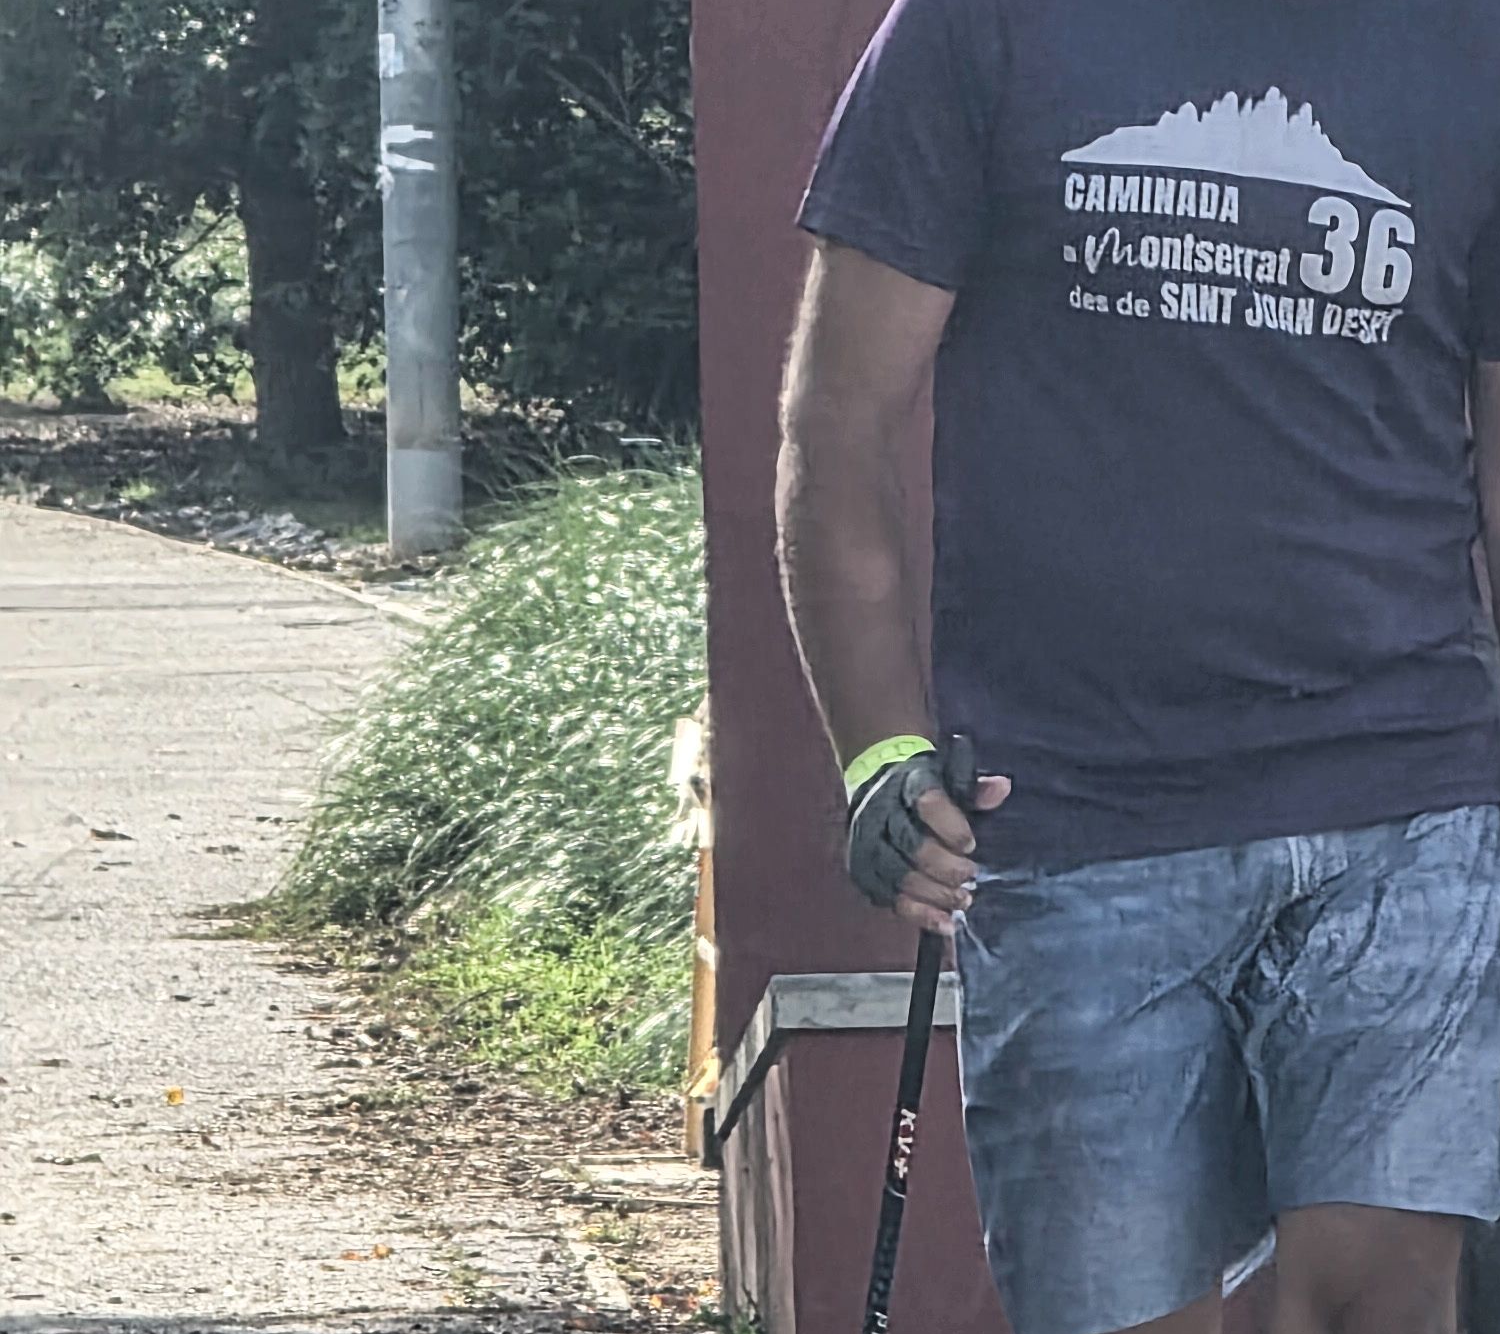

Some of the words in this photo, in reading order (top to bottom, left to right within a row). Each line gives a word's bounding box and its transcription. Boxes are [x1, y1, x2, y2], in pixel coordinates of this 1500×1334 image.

[1064, 172, 1239, 225] CAMINADA
[1085, 226, 1290, 286] Montserrat
[1299, 196, 1416, 305] 36
[1069, 284, 1109, 313] des
[1116, 291, 1150, 317] de
[1160, 281, 1238, 325] SANT
[1245, 289, 1315, 336] JOAN
